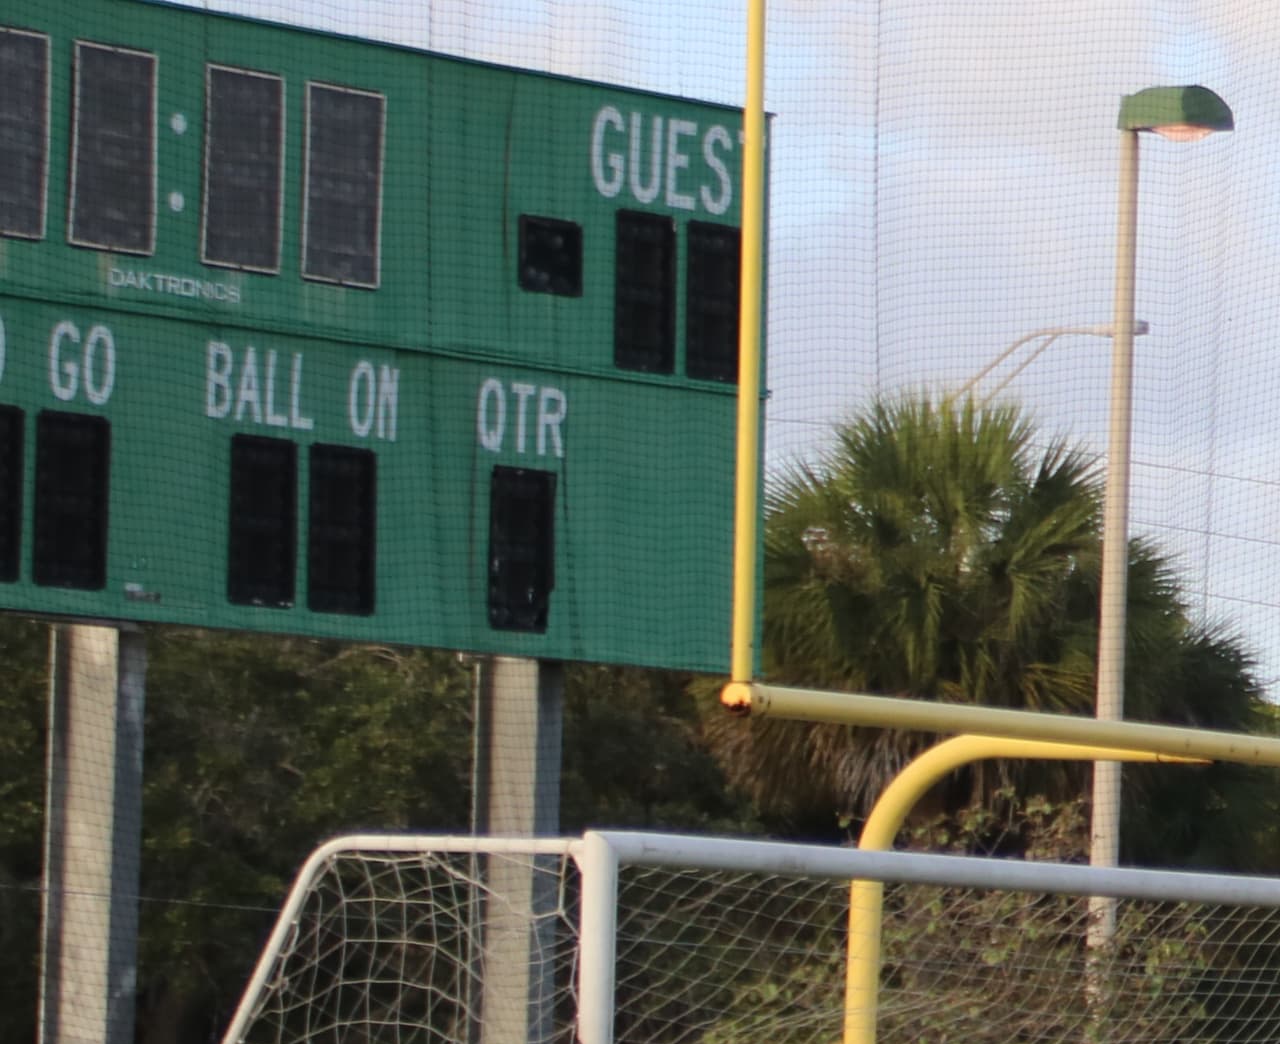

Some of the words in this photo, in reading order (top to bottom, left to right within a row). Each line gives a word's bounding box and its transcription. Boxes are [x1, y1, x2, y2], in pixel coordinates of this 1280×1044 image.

[590, 105, 748, 216] GUES
[110, 268, 241, 302] DAKTRONICS
[48, 321, 117, 405] GO
[204, 341, 315, 431] BALL
[348, 360, 400, 442] ON
[476, 378, 568, 459] QTR
